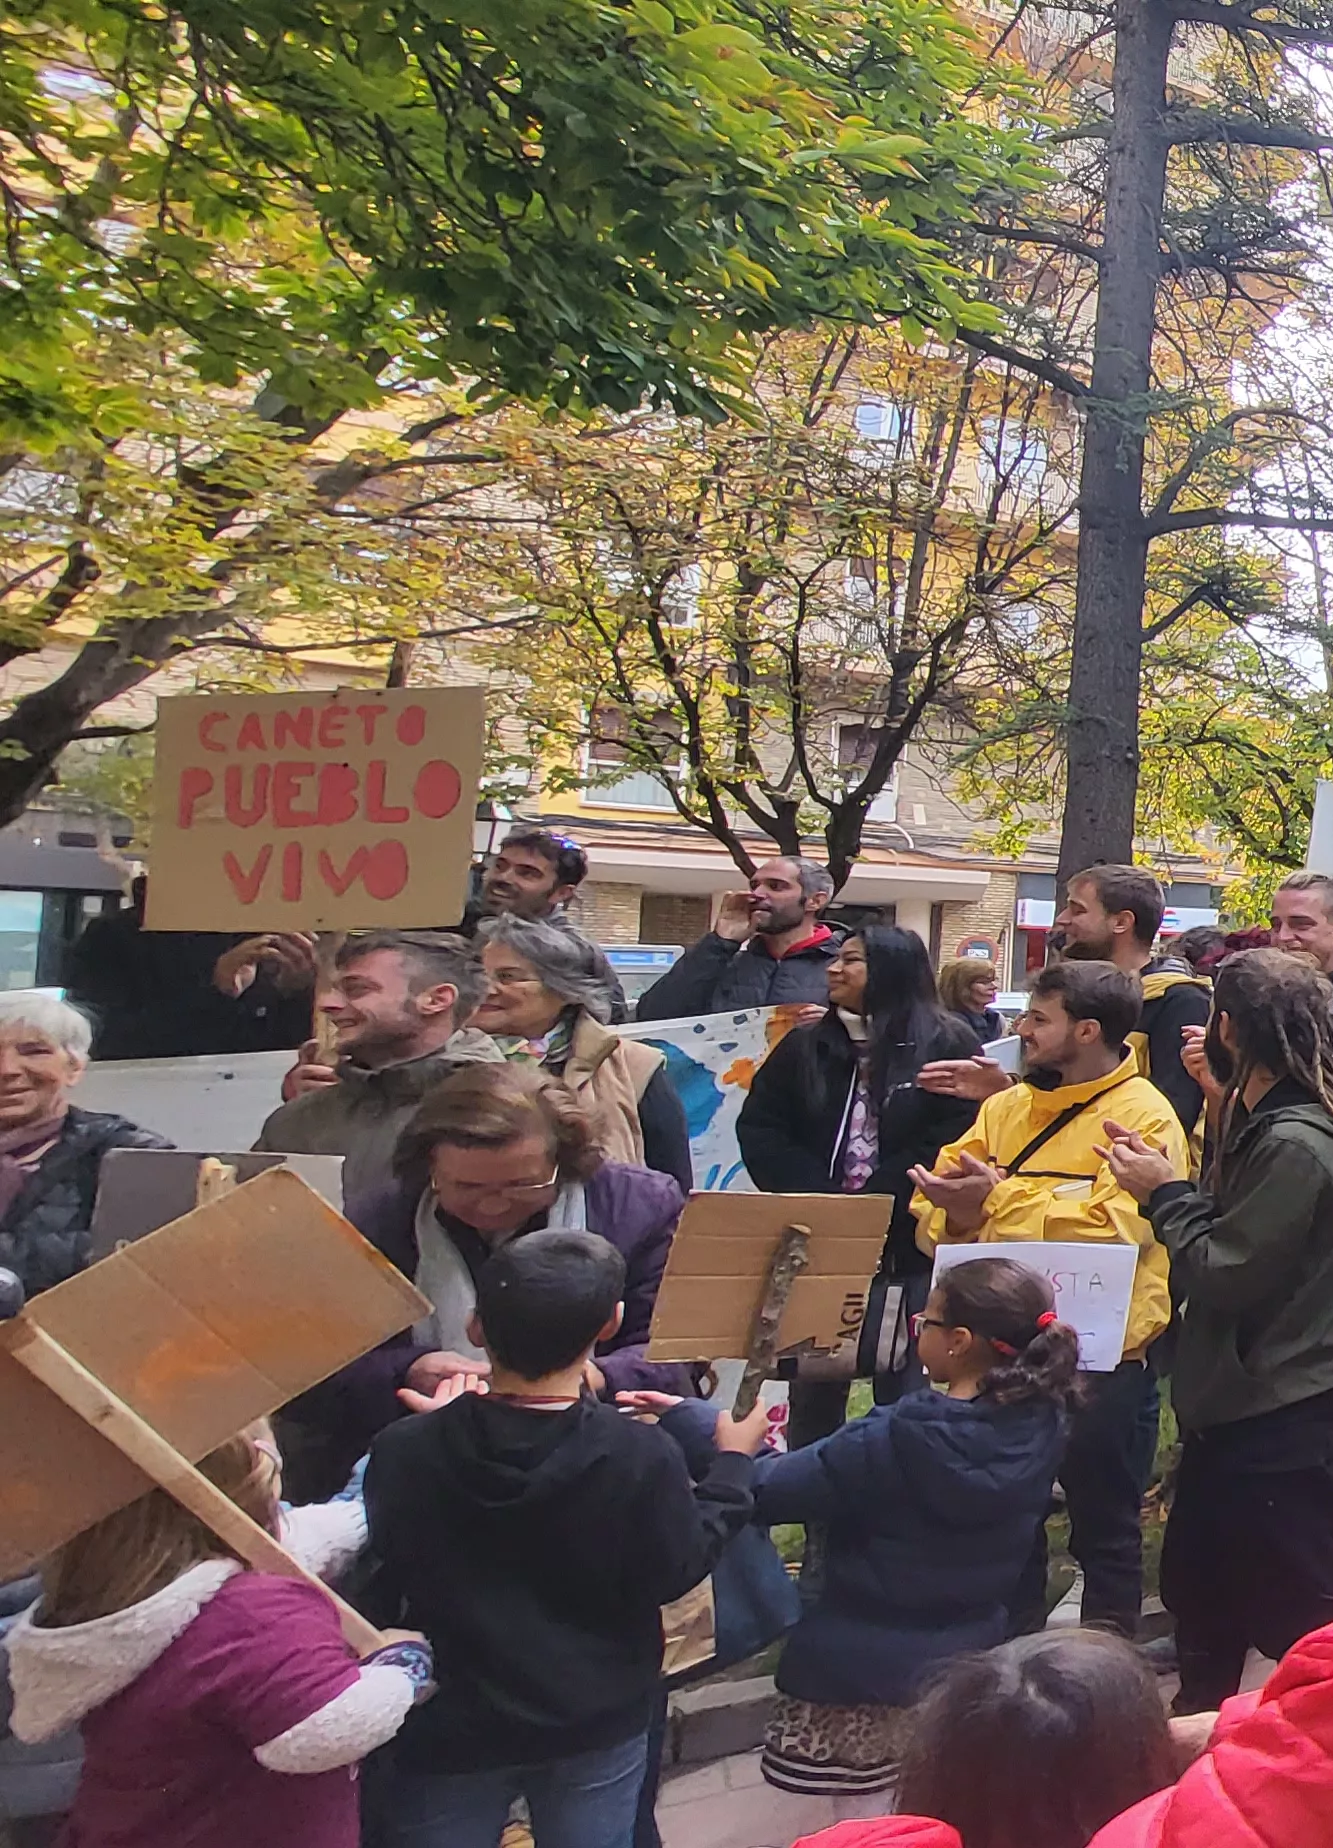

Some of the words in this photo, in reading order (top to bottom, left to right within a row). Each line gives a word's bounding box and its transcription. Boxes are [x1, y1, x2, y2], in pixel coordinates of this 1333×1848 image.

[198, 704, 427, 751] CANETO
[177, 759, 461, 829] PUEBLO
[222, 838, 409, 904] VIVO
[1046, 1268, 1104, 1298] STA
